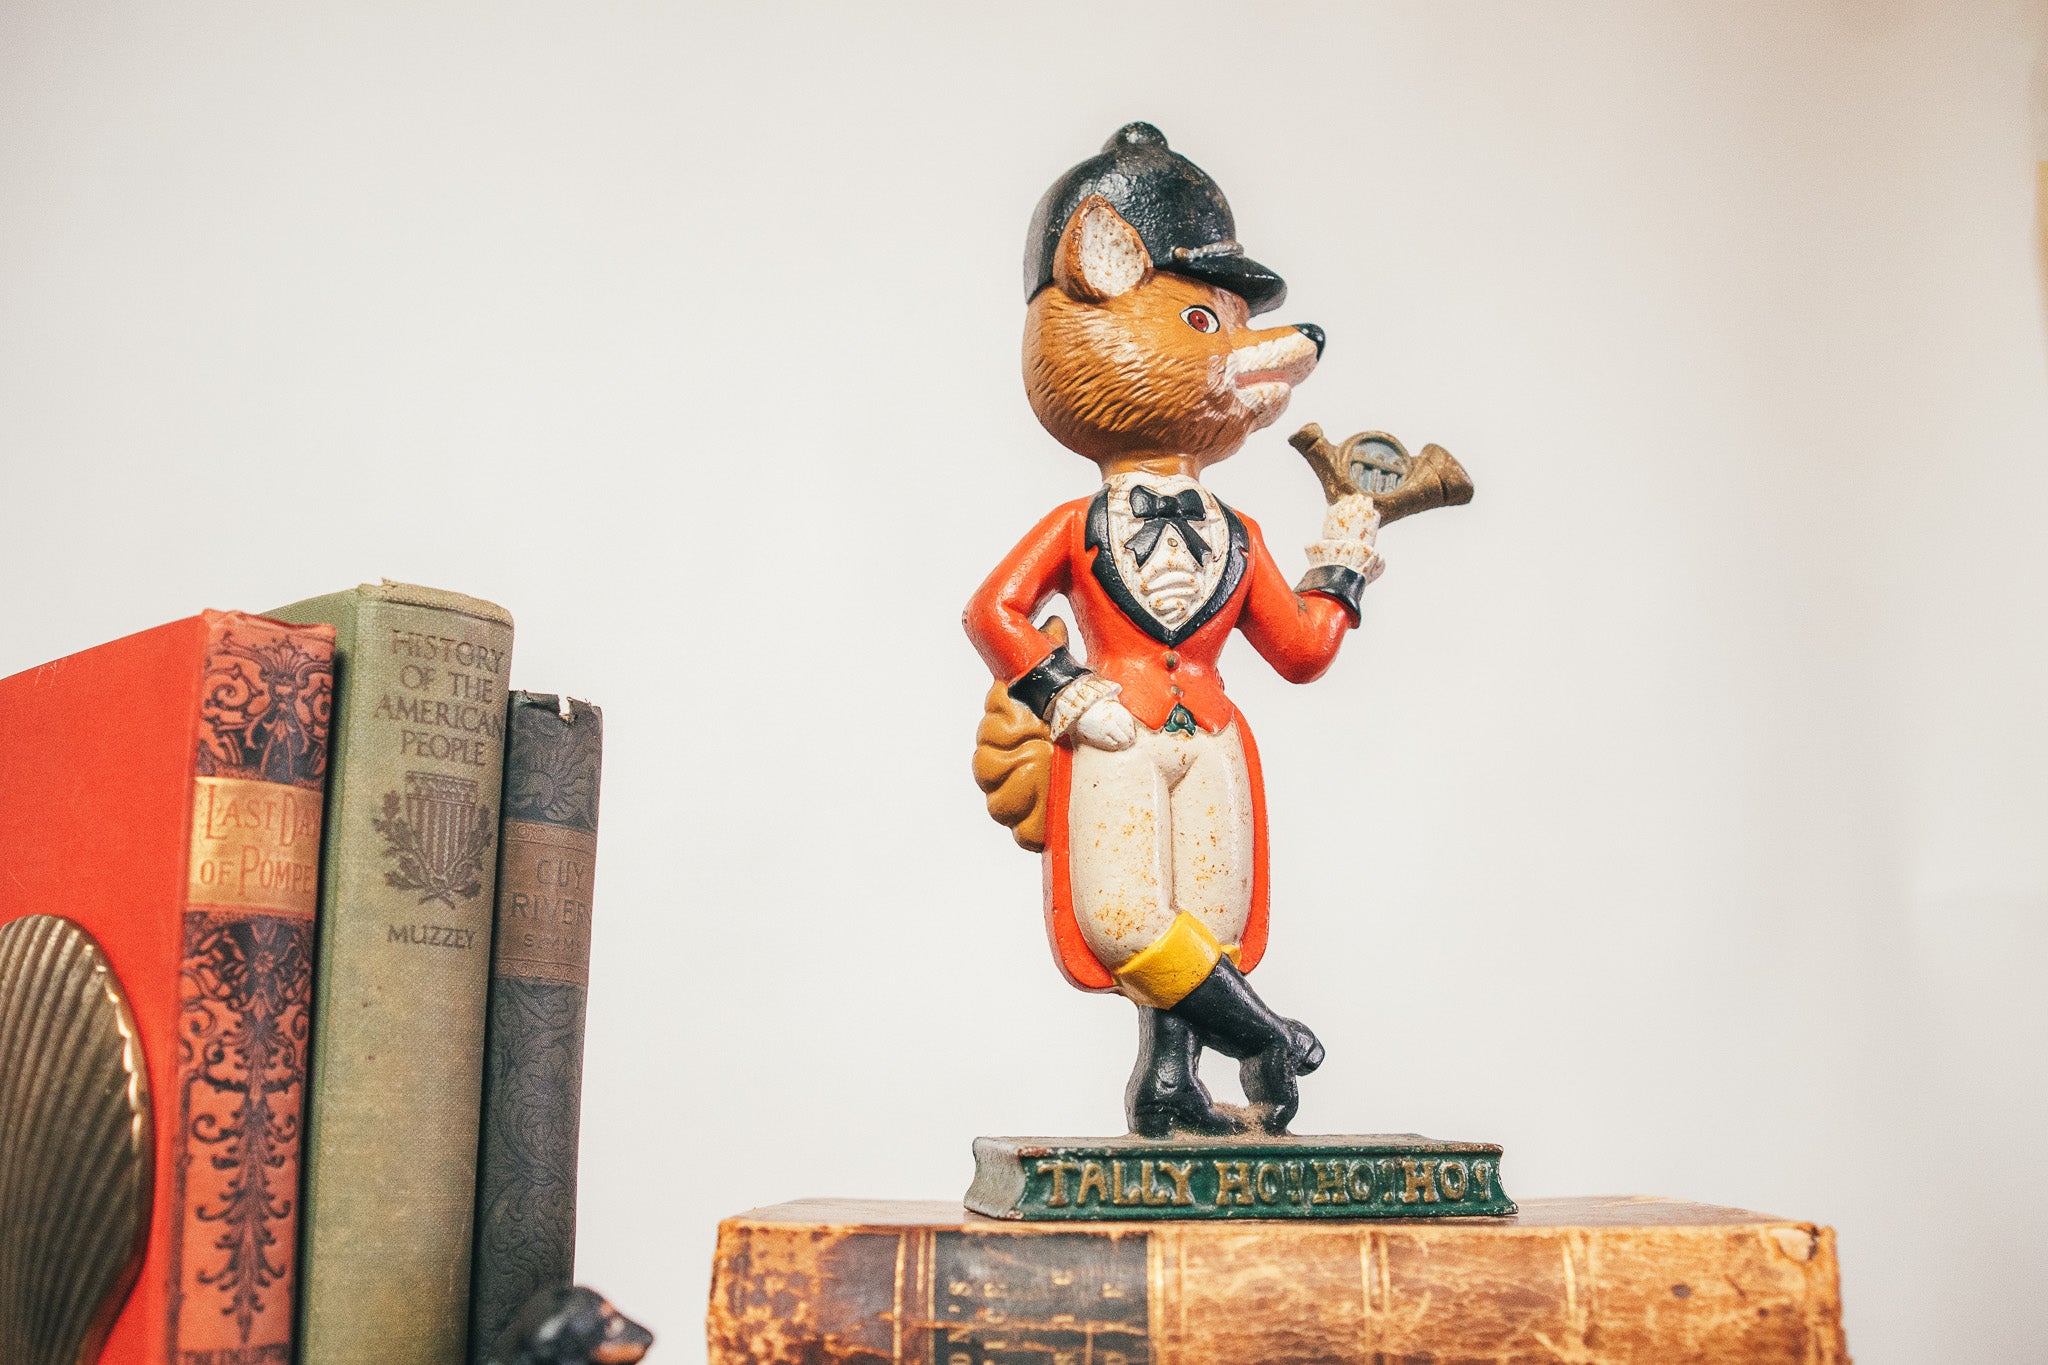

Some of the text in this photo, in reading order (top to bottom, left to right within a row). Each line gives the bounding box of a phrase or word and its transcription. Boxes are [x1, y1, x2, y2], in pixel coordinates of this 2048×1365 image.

[391, 629, 504, 674] HISTORY
[401, 664, 493, 704] OF THE
[372, 694, 504, 738] AMERICAN
[400, 729, 486, 766] PEOPLE
[206, 784, 277, 840] LAST
[200, 845, 315, 897] OF POMPE
[387, 925, 476, 949] MUZZEY
[1037, 1158, 1491, 1206] TALLY HO! HO! HO!
